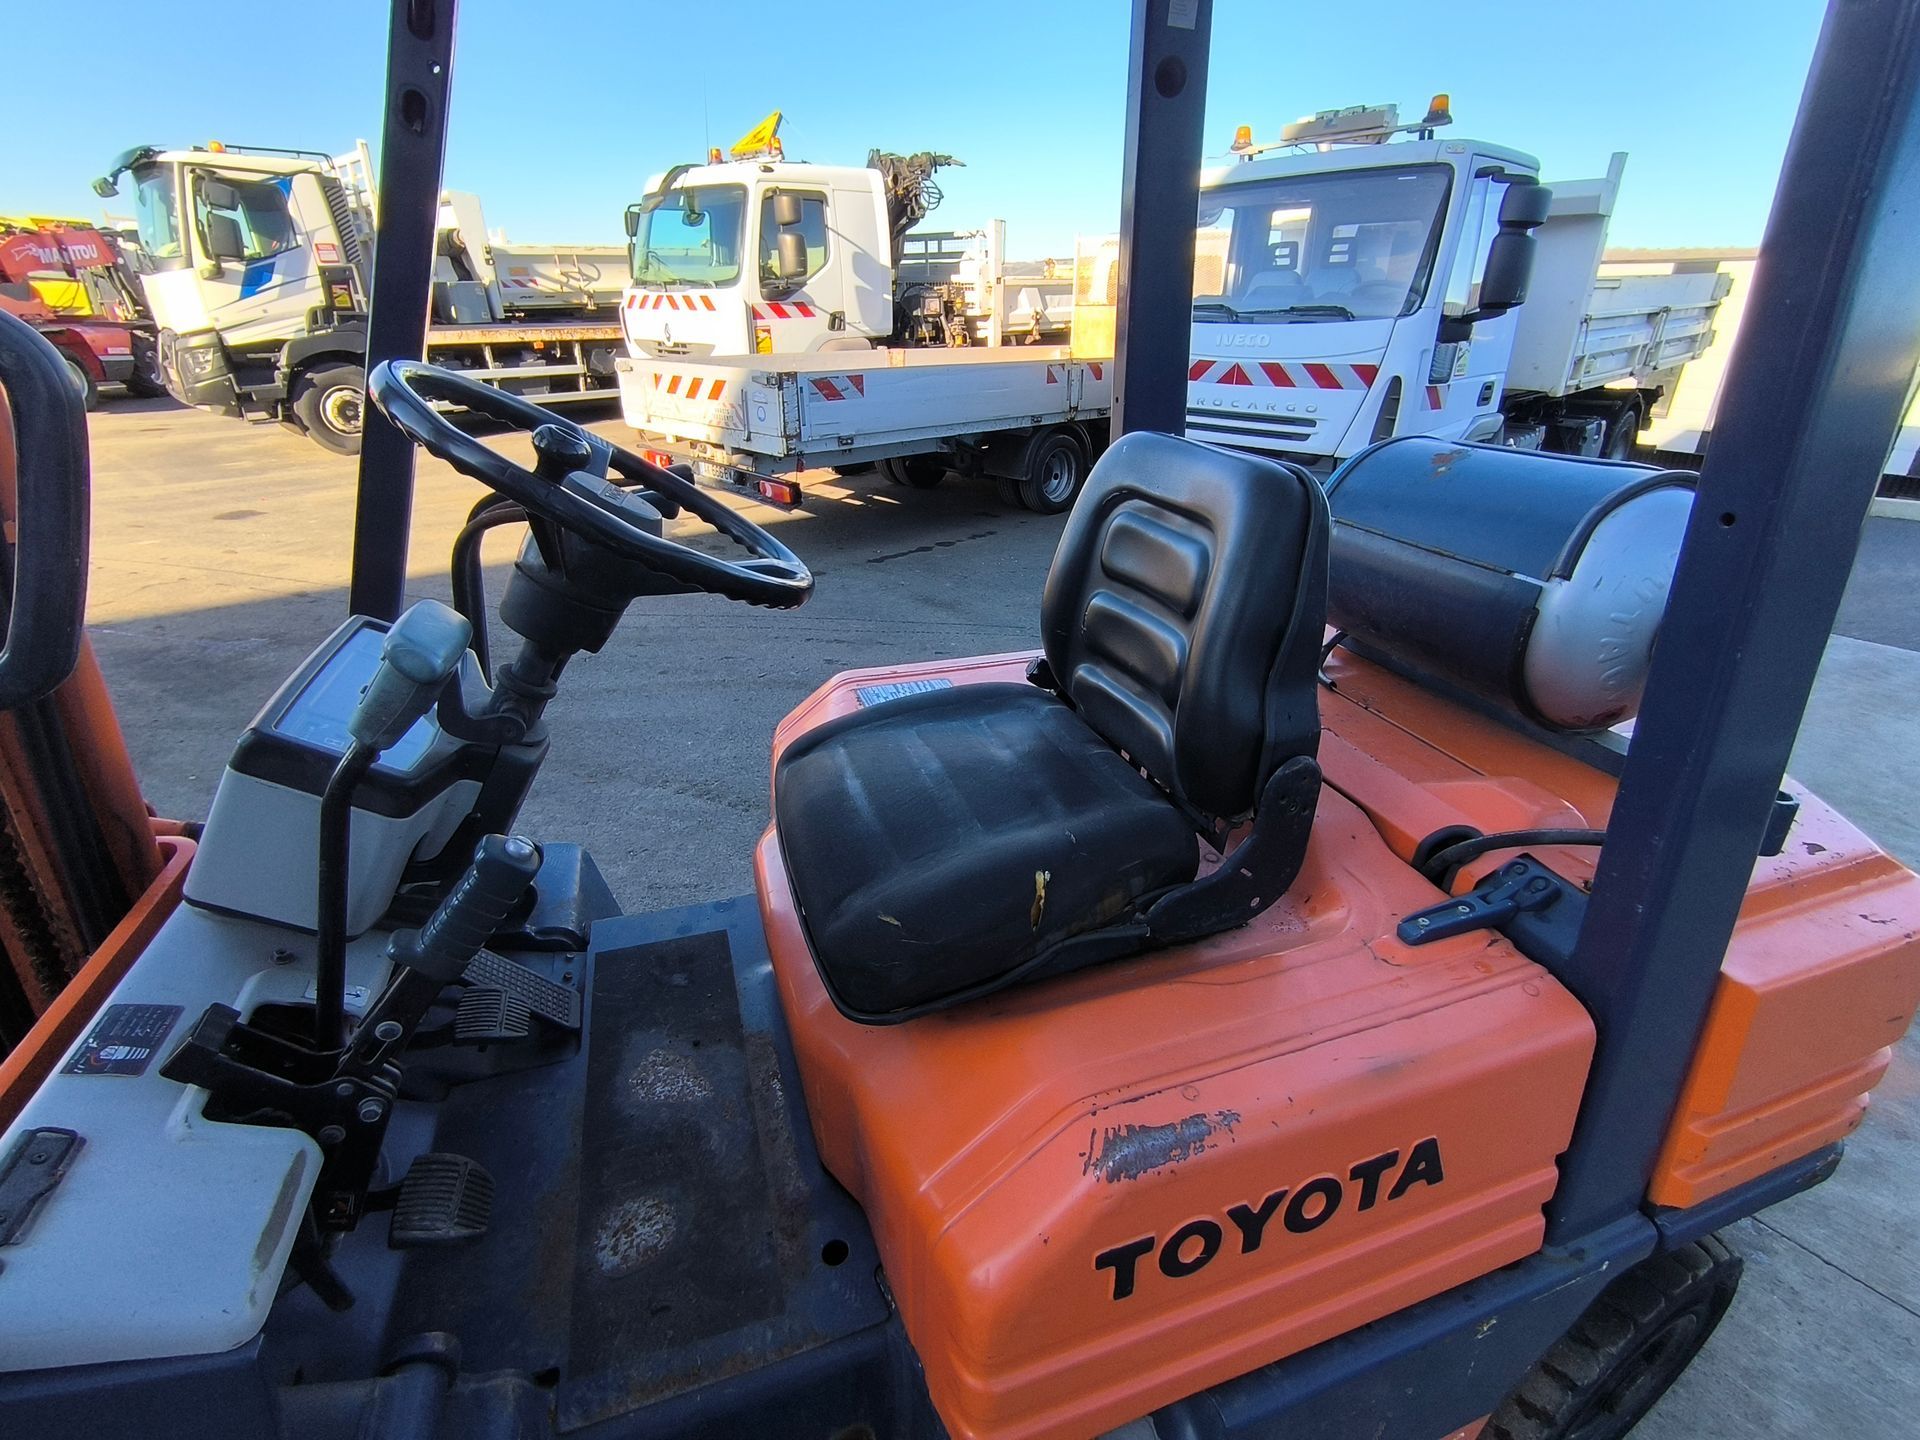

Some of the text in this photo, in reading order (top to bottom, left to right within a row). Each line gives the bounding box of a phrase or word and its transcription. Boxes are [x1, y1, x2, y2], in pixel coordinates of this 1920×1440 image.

[1215, 333, 1271, 348] IVECO
[1195, 397, 1318, 413] ROCARGO
[1095, 1137, 1444, 1300] TOYOTA
